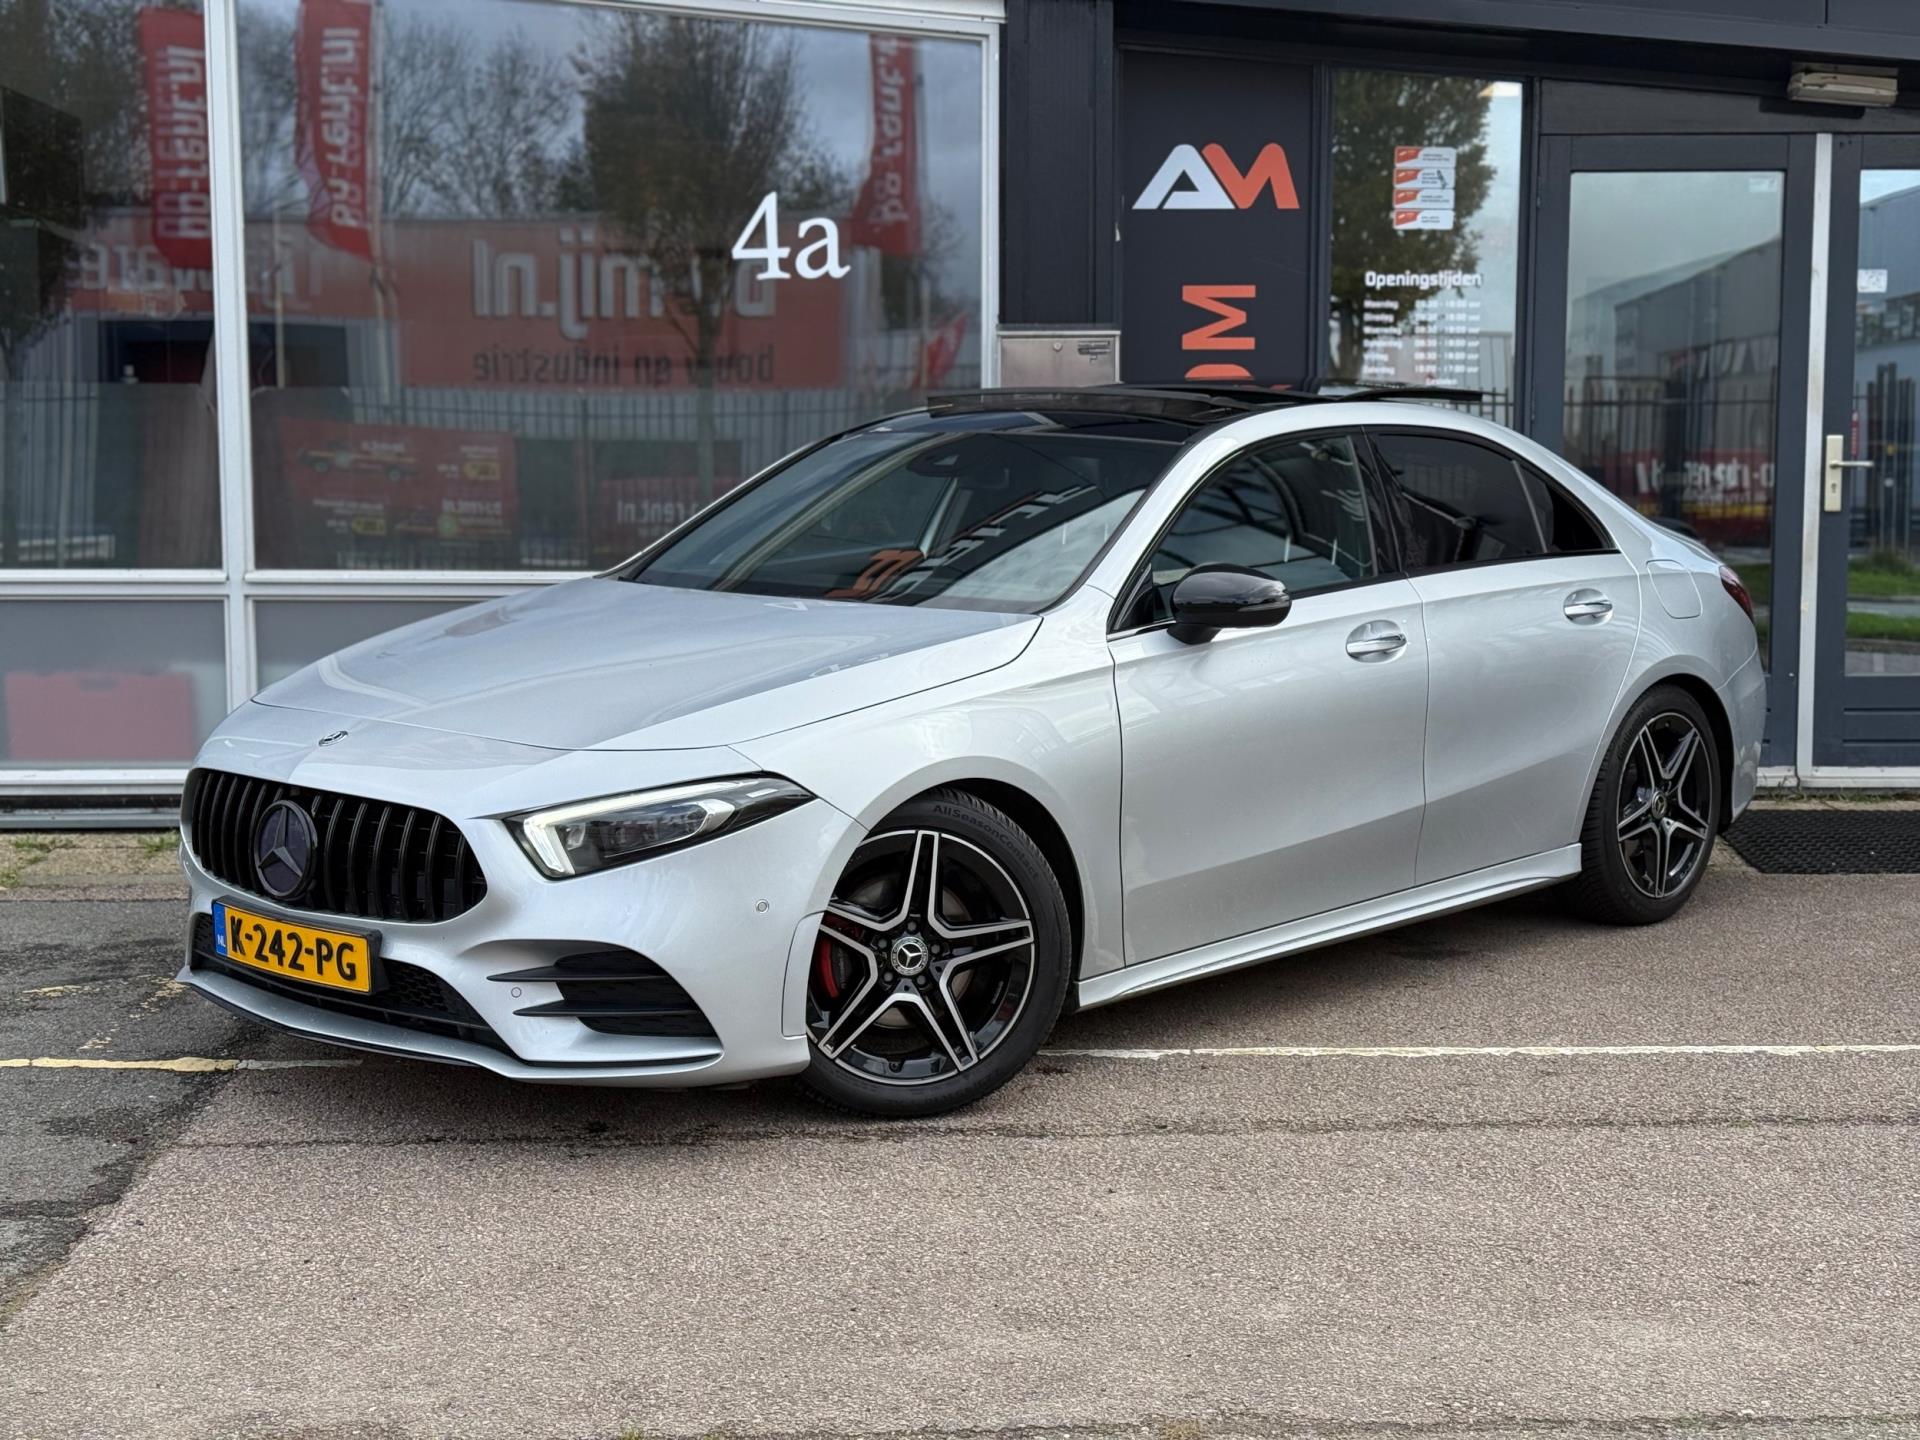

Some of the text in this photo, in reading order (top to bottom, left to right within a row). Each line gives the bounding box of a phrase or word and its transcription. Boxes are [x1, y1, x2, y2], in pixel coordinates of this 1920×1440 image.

[1131, 142, 1300, 210] AM
[731, 191, 851, 281] 4a
[1365, 270, 1482, 289] Openingstijden
[1182, 284, 1256, 381] M
[217, 934, 226, 947] NL
[230, 915, 357, 981] K-242-PG
